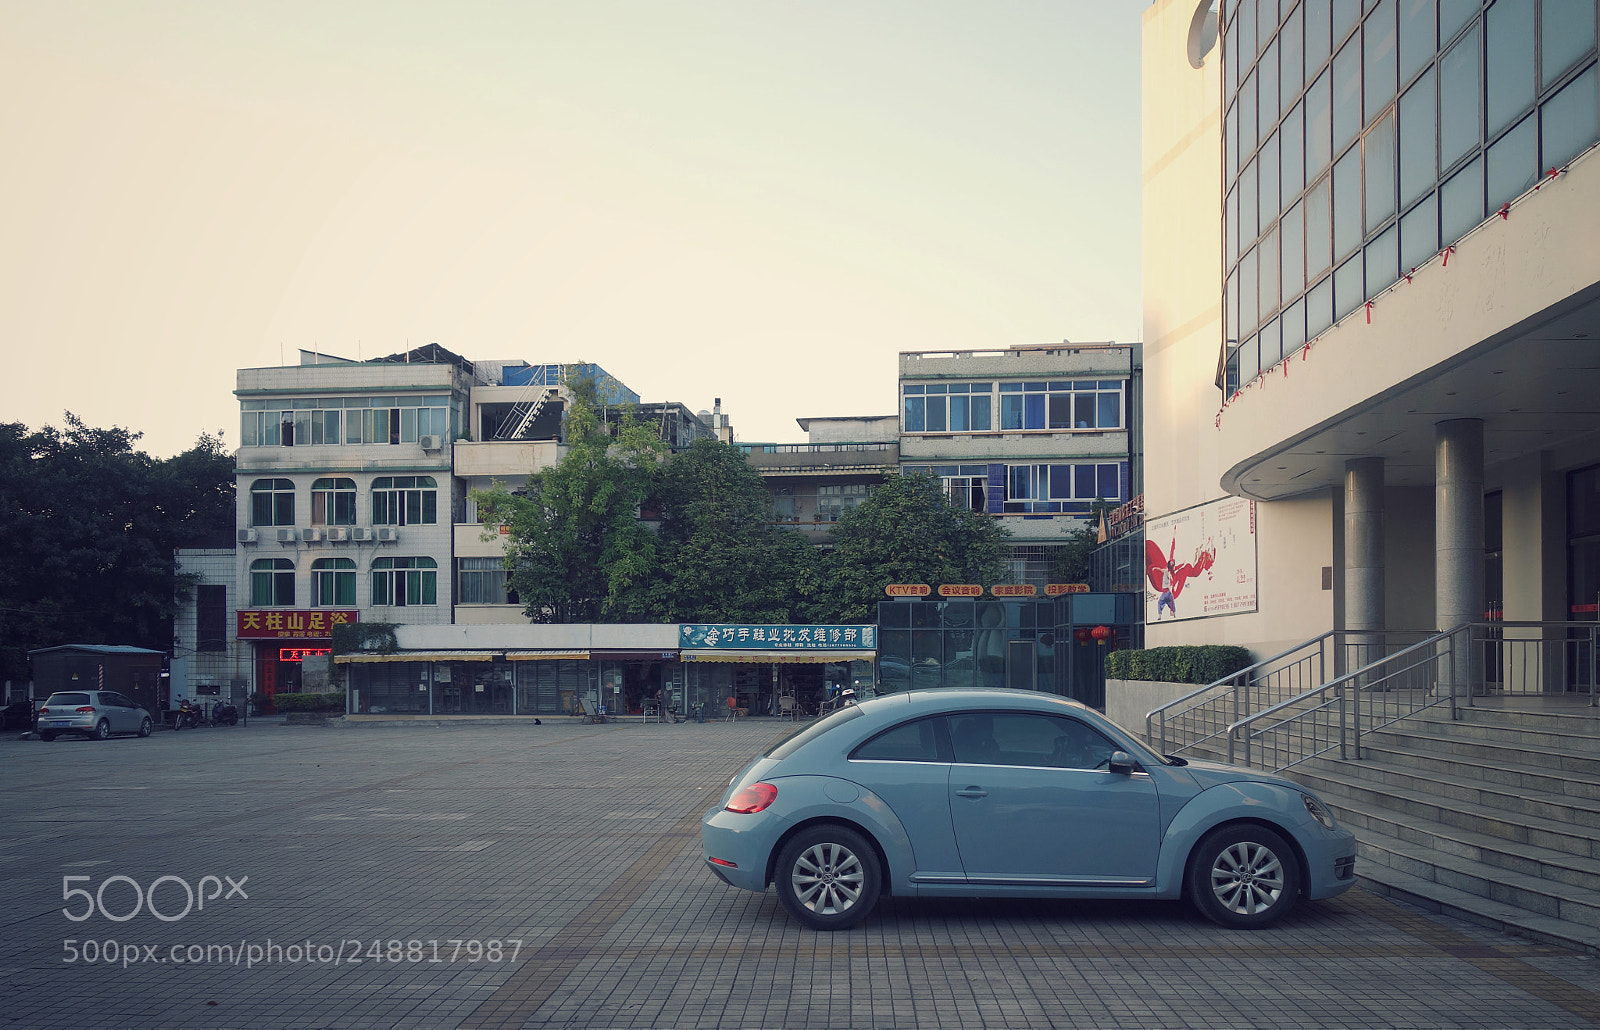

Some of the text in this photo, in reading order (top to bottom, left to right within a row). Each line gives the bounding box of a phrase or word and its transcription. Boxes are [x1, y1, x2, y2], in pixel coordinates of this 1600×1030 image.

[889, 585, 929, 595] KTV音响
[941, 585, 981, 595] 会议音响
[994, 585, 1034, 595] 家庭影院
[243, 612, 349, 630] 天柱山足浴
[707, 626, 858, 642] 金巧手鞋业批发维修部
